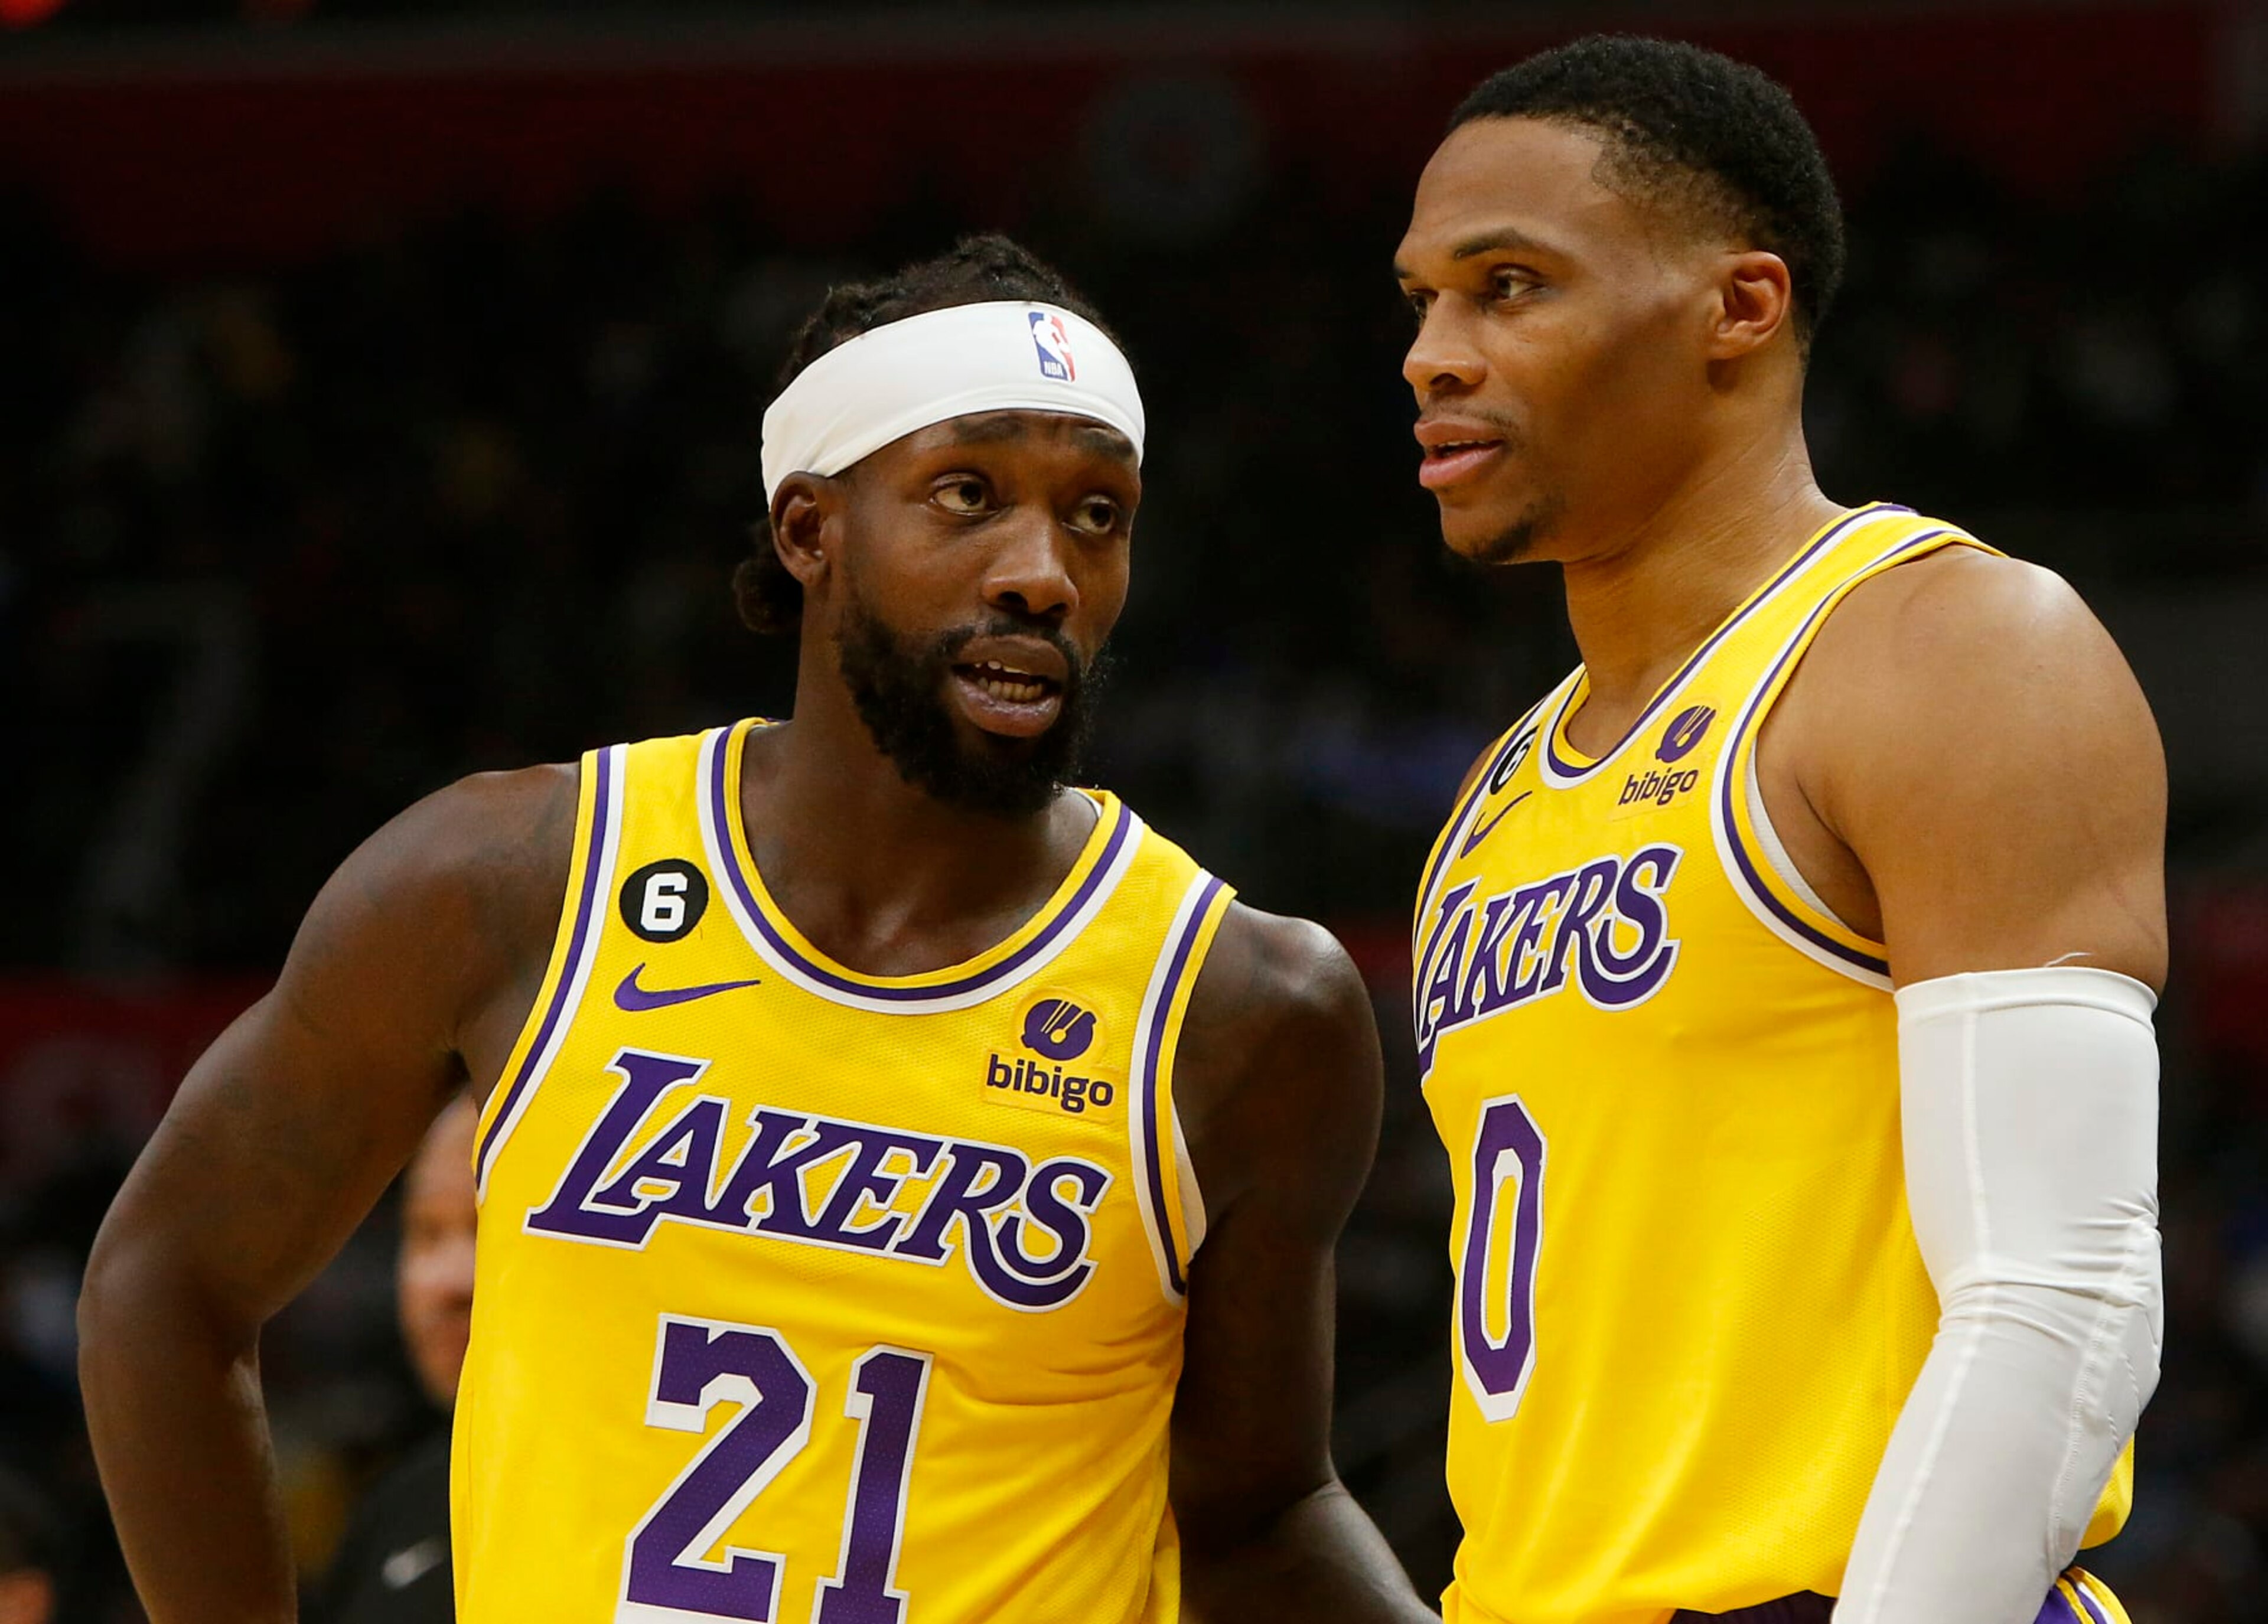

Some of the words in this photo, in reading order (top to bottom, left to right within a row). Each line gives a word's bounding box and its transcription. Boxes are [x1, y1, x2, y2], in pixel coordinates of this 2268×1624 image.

[1618, 767, 1699, 806] bibigo
[640, 872, 689, 932] 6
[986, 1054, 1113, 1113] bibigo
[523, 1046, 1114, 1313] LAKERS
[1458, 1093, 1547, 1423] 0
[614, 1312, 934, 1624] 21
